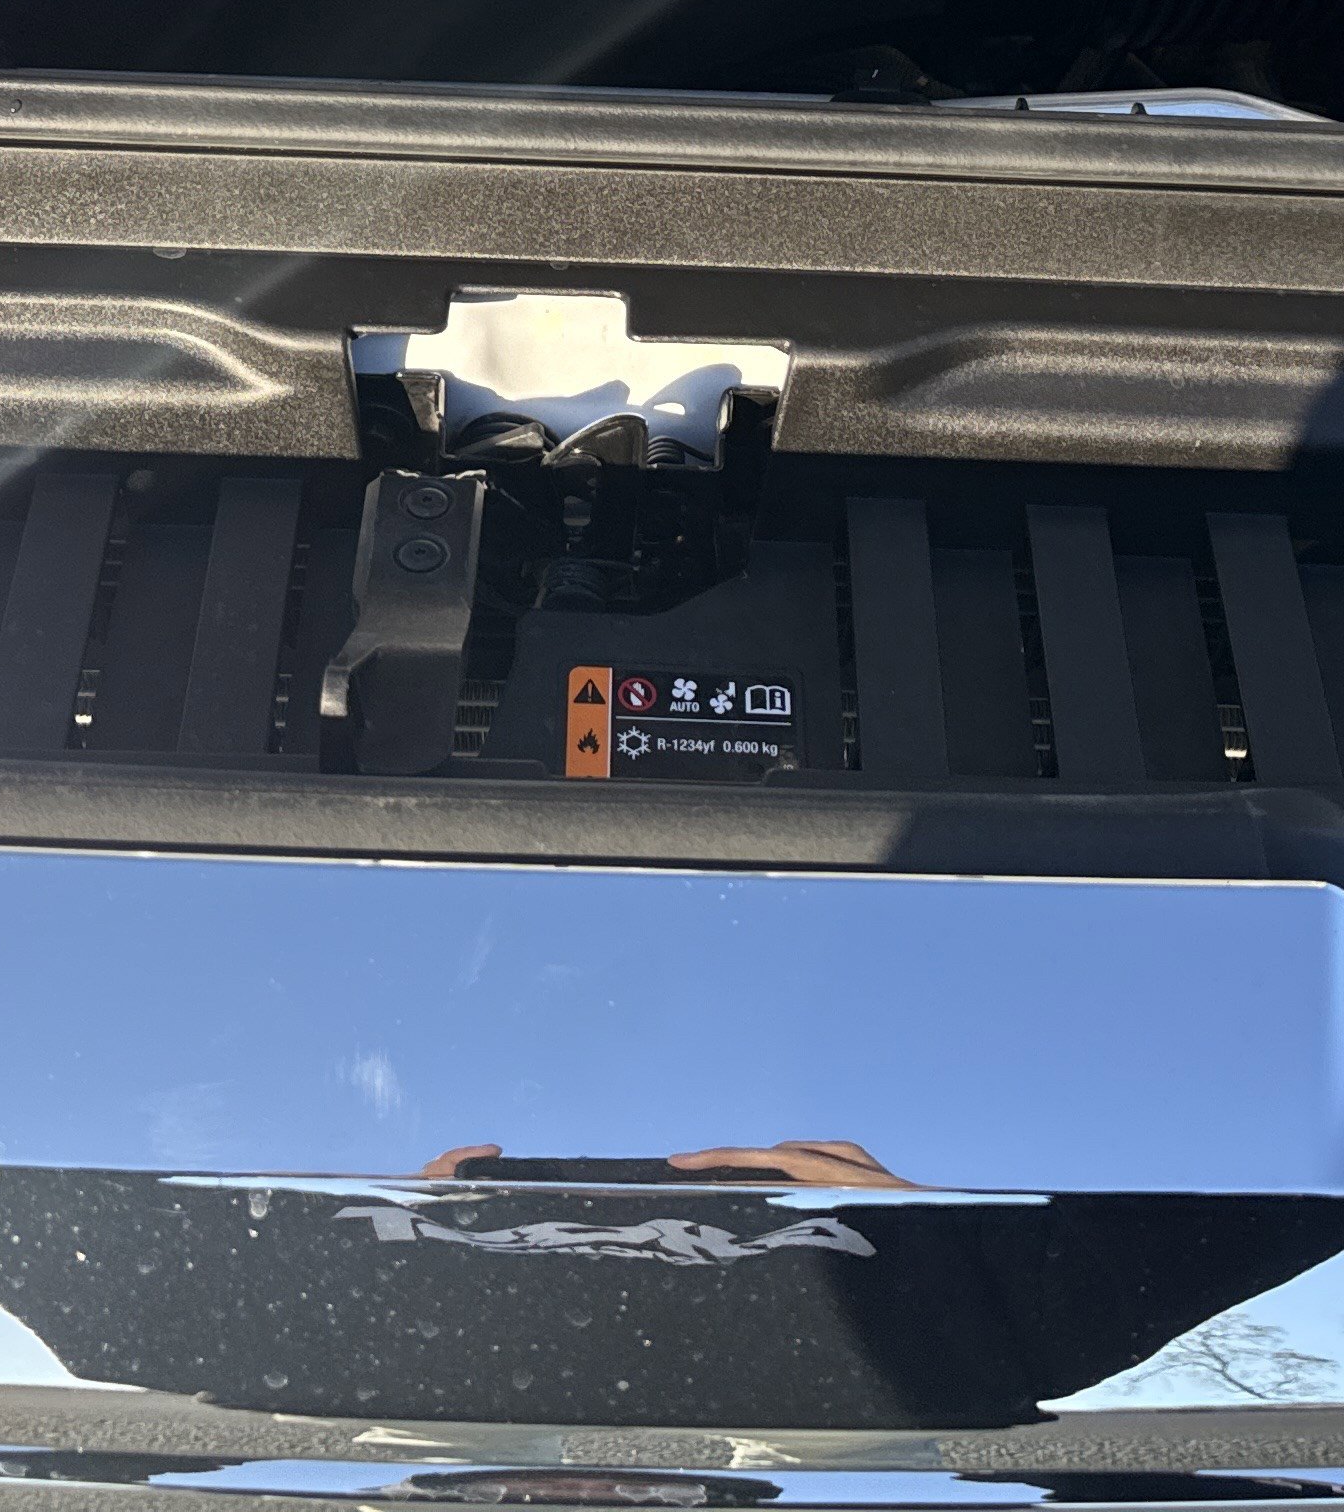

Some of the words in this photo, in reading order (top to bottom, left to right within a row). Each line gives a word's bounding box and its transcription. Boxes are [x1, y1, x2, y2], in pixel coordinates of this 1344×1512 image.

[669, 701, 700, 713] AUTO
[657, 737, 716, 755] R-1234yf
[723, 740, 759, 754] 0.600
[761, 741, 779, 757] kg
